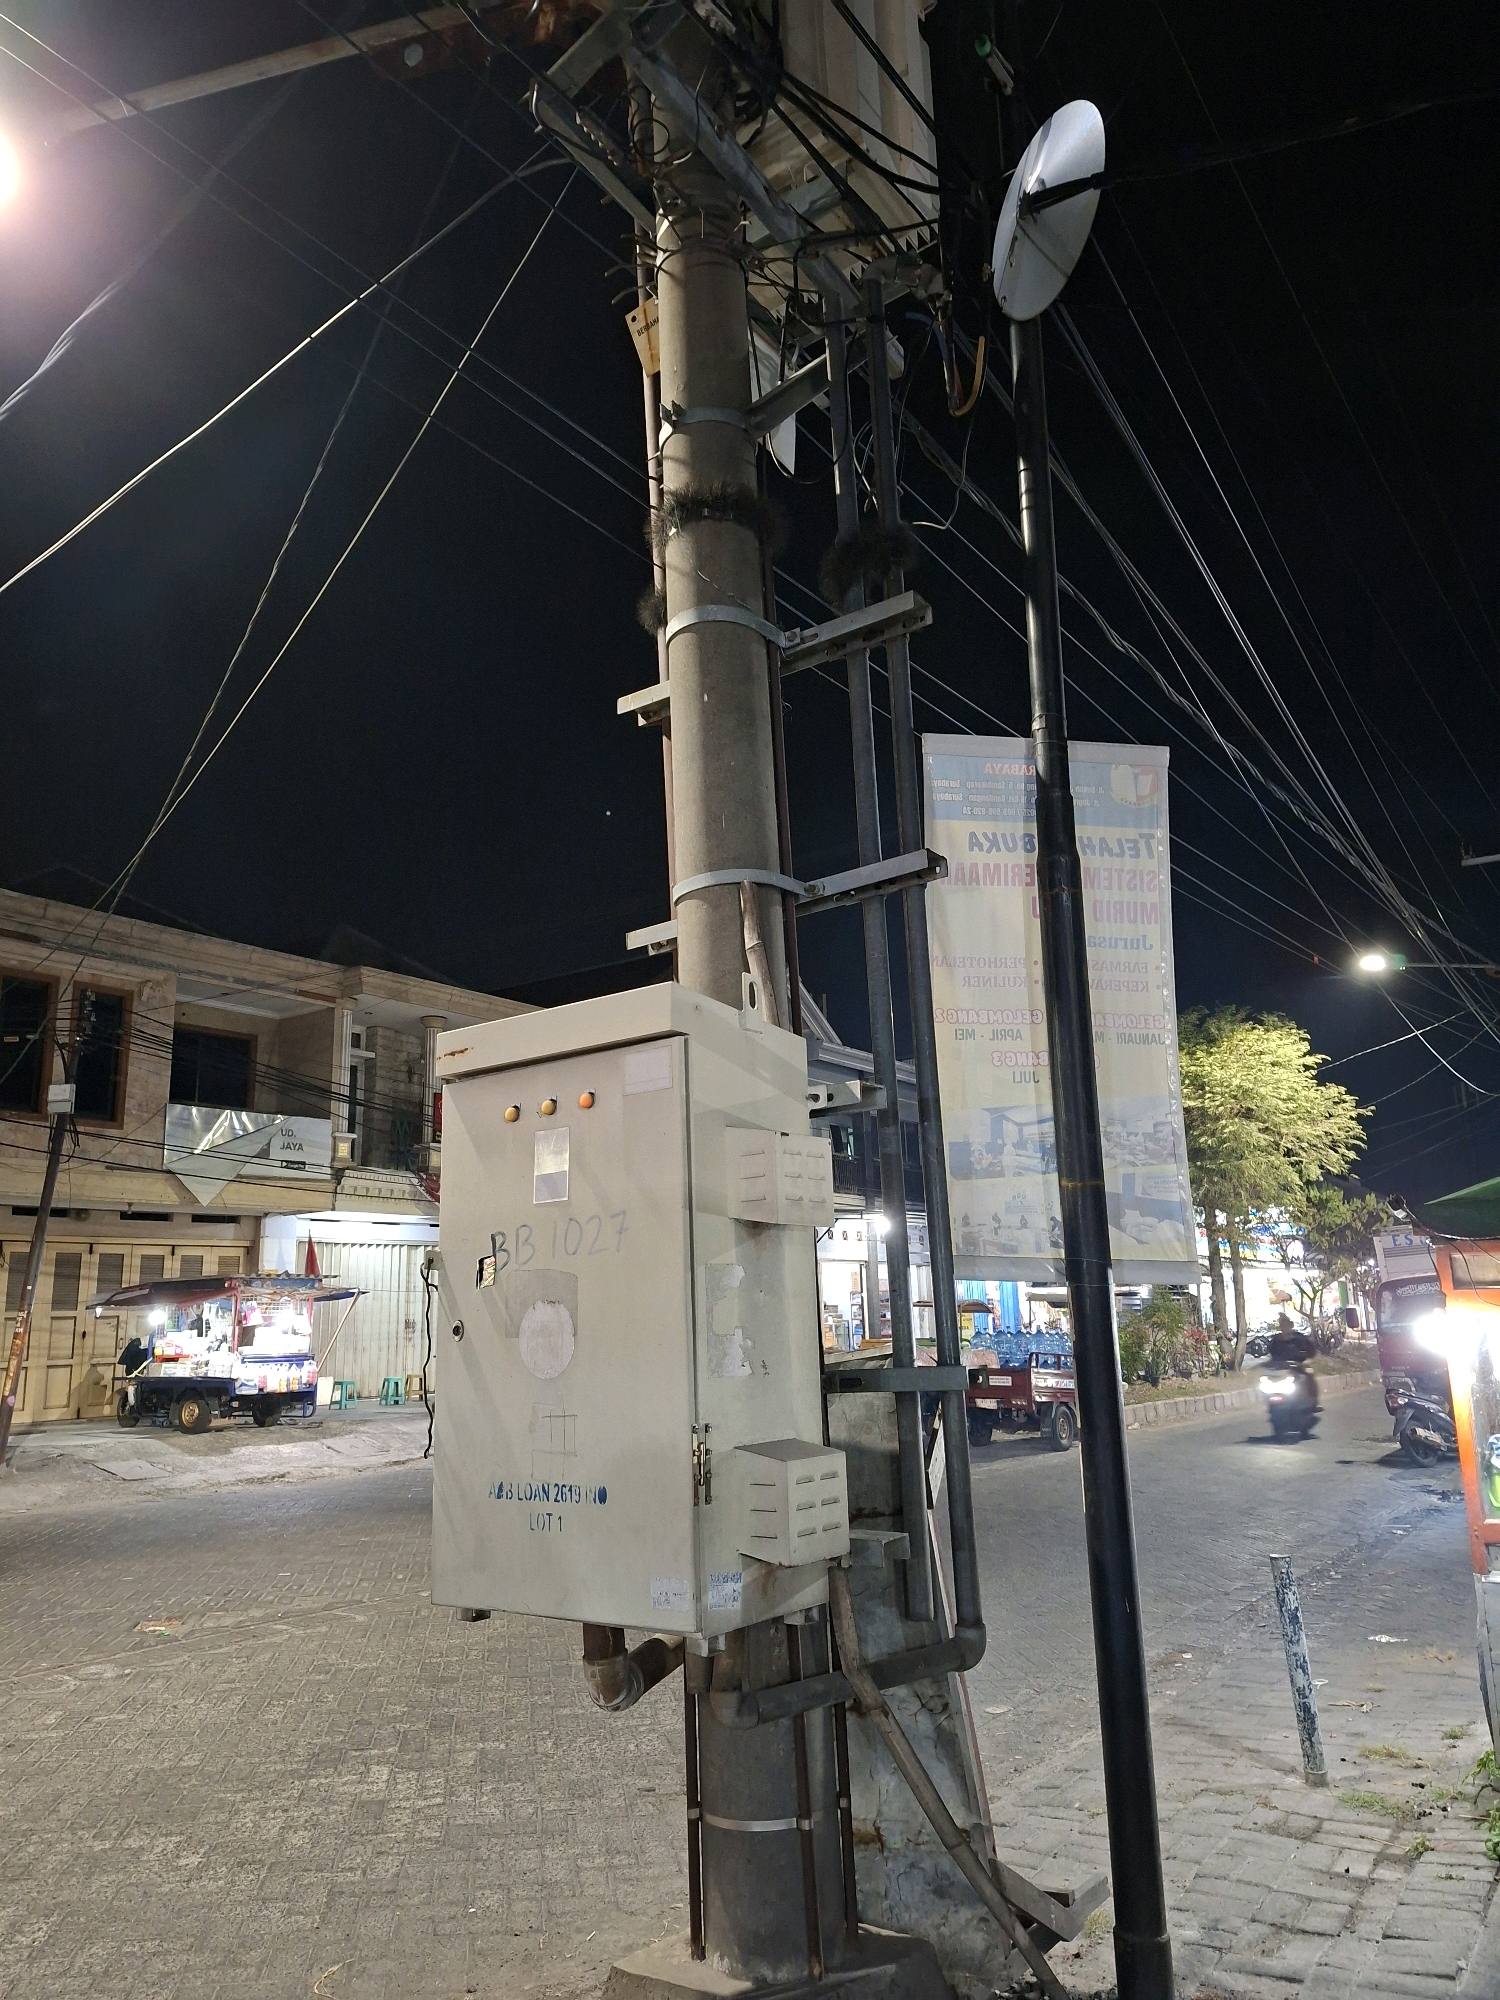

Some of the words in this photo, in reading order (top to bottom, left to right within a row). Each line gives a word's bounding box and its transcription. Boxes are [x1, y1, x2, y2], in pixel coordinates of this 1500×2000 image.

[280, 1141, 304, 1151] JAYA
[491, 1224, 536, 1273] BB
[551, 1209, 629, 1258] 1027
[517, 1482, 549, 1502] LOAN
[554, 1483, 581, 1504] 2619
[529, 1512, 553, 1532] LOT
[557, 1514, 562, 1532] 1
